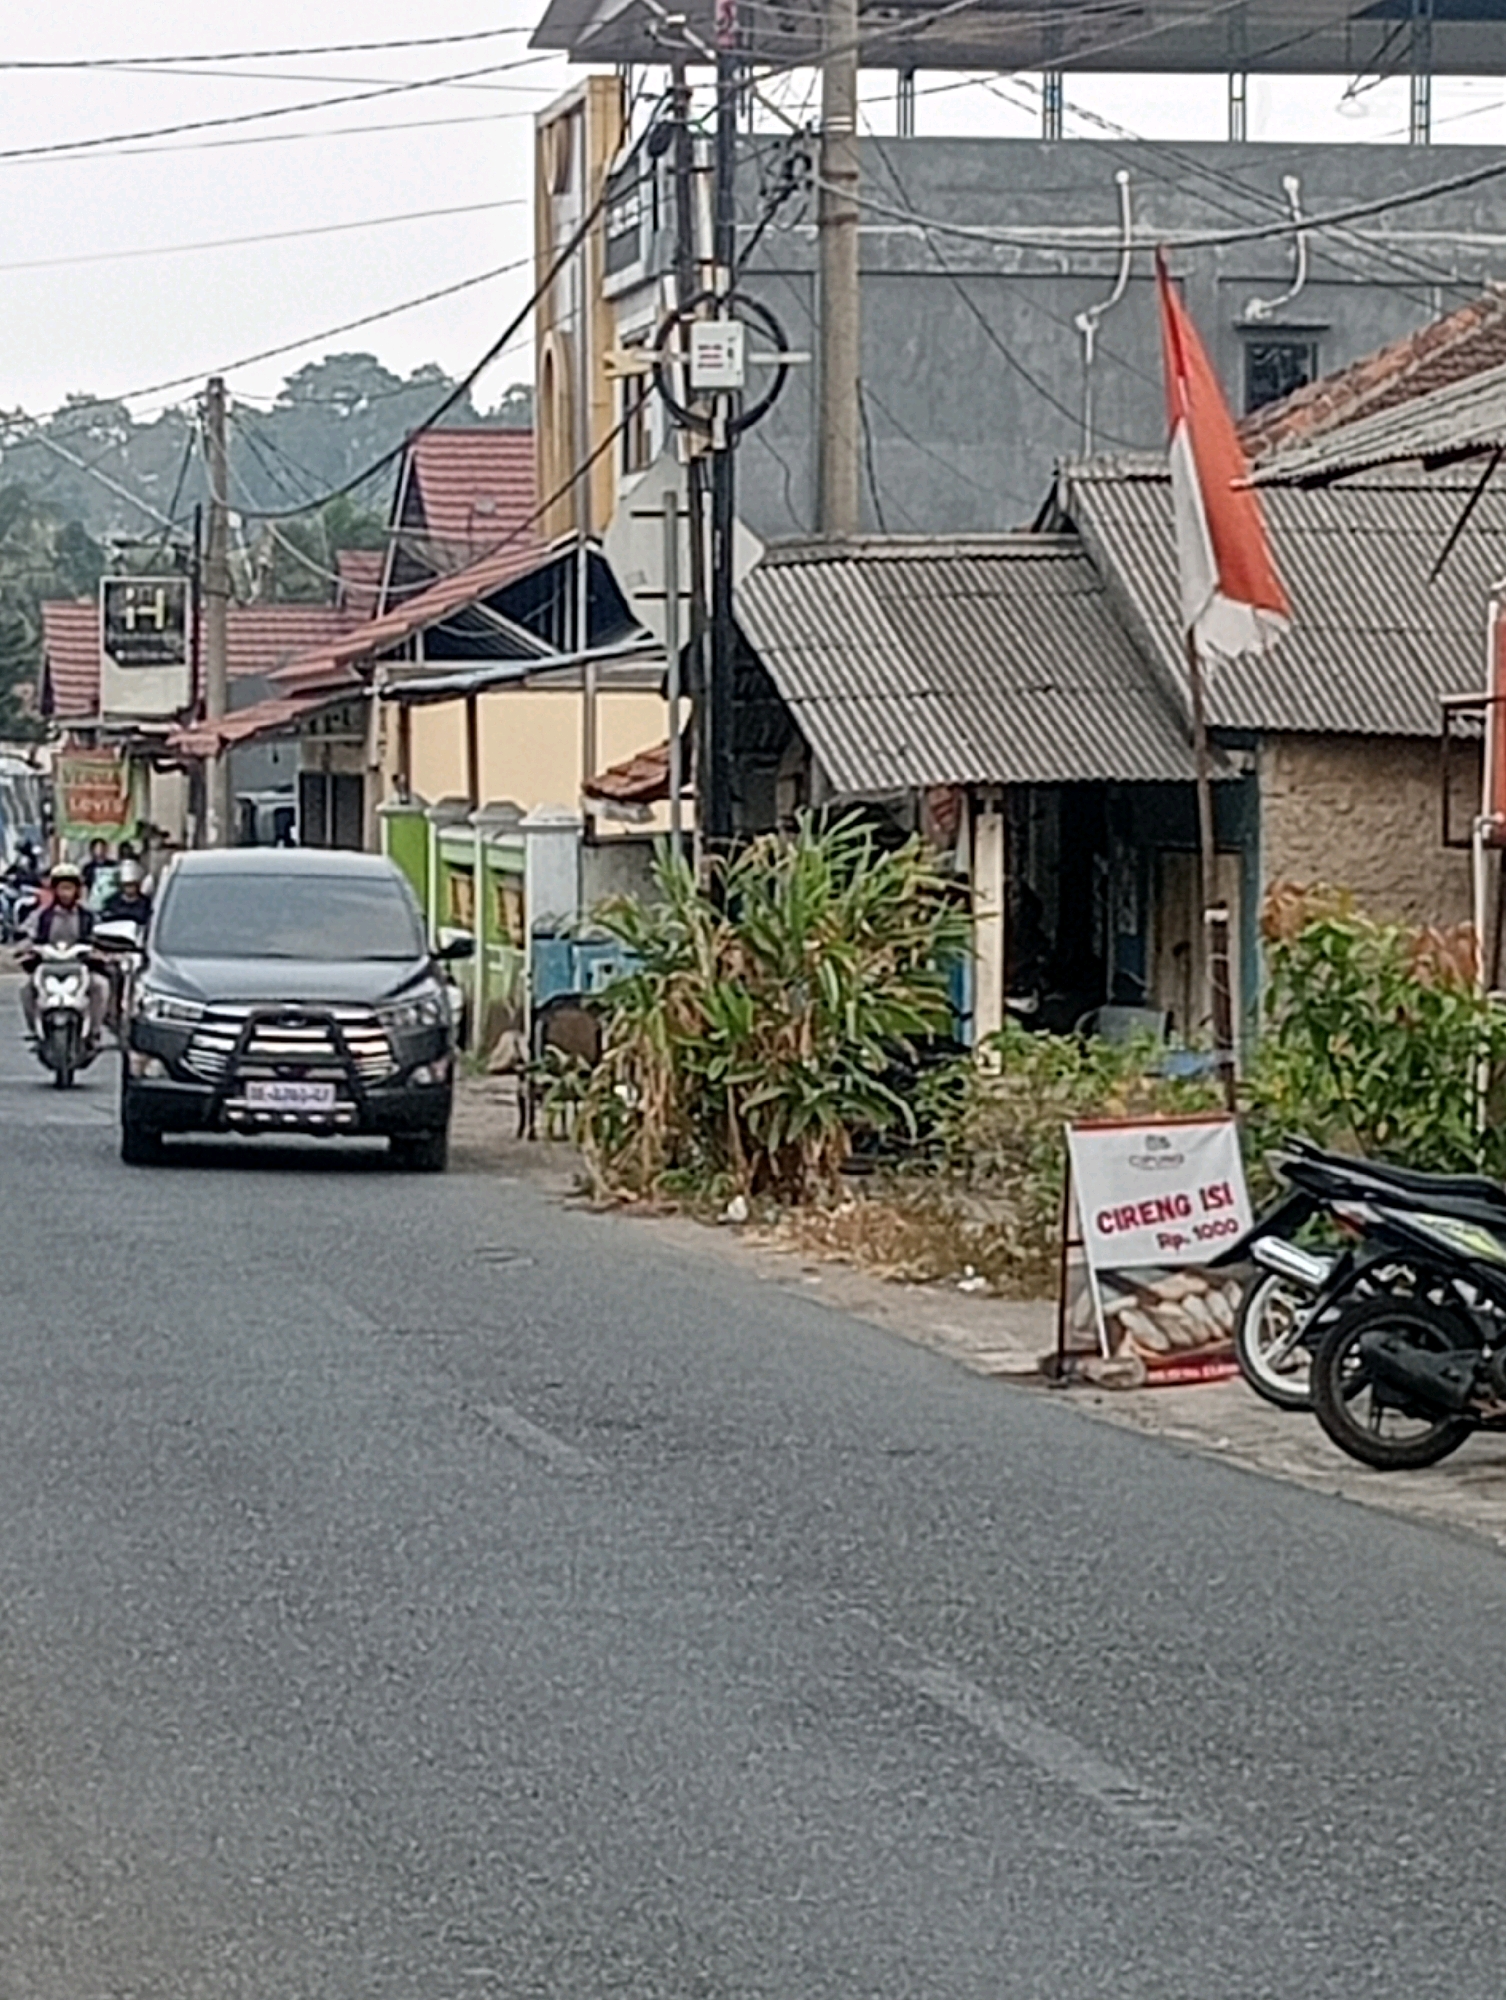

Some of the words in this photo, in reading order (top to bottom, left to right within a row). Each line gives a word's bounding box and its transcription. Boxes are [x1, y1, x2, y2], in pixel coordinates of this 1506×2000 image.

[1096, 1193, 1192, 1235] CIRENG
[1198, 1181, 1234, 1212] ISI
[1192, 1217, 1239, 1241] 1000
